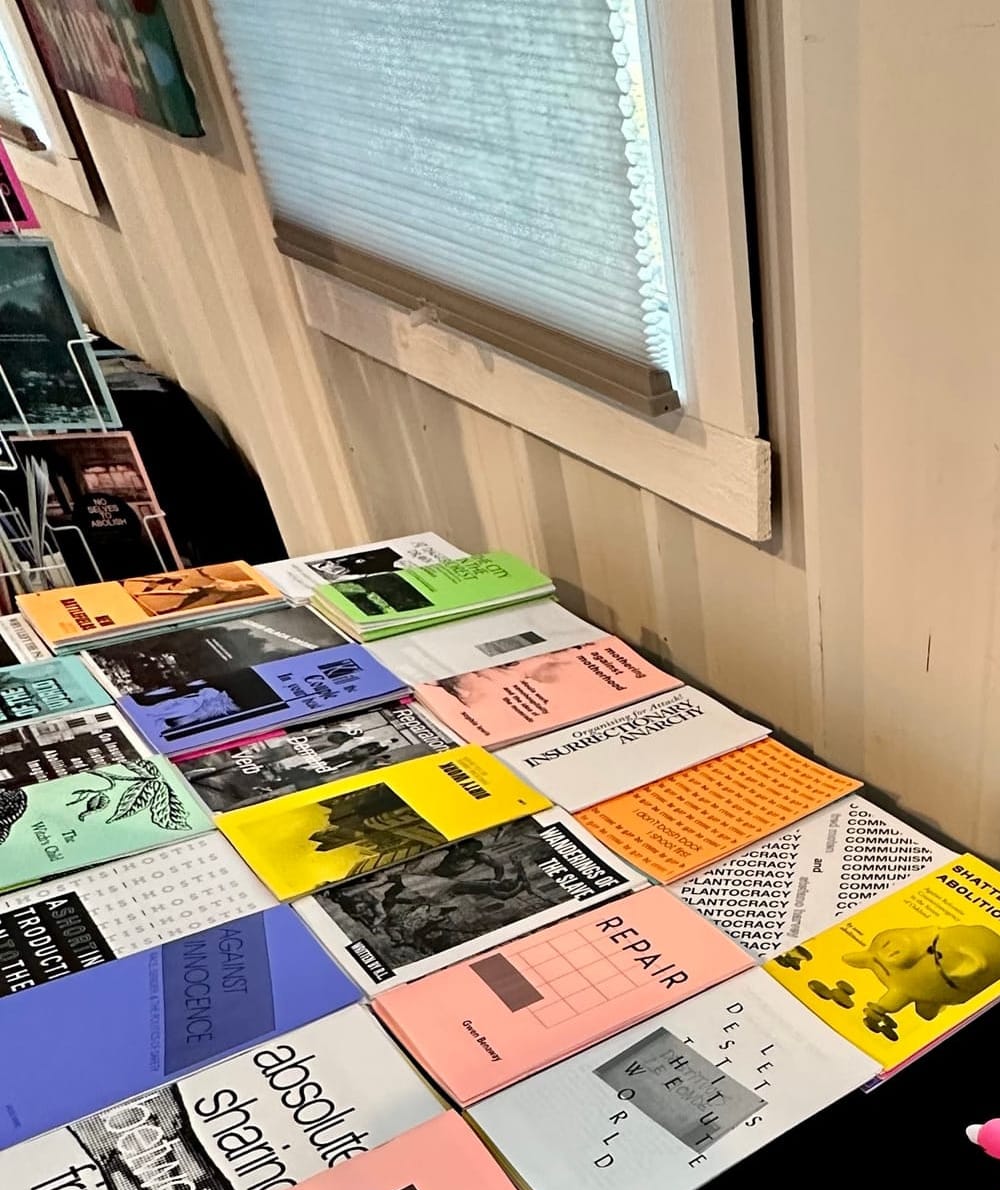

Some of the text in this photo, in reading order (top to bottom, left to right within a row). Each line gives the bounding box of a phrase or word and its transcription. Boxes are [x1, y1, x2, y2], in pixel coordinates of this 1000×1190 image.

[576, 655, 627, 691] motherhood
[591, 651, 624, 676] against
[604, 647, 647, 679] mothering
[524, 698, 693, 768] INSURRECTIONARY
[619, 705, 705, 745] ANARCHY
[534, 826, 610, 880] WANDERINGS
[592, 874, 620, 889] OF
[842, 854, 933, 863] COMMUNISM
[535, 857, 595, 900] THE SLAVE
[681, 887, 792, 898] PLANTOCRACY
[218, 928, 248, 995] AGAINST
[596, 915, 689, 990] REPAIR
[183, 941, 214, 1045] INNOCENCE
[462, 1019, 480, 1039] Gwen
[594, 1060, 646, 1169] WORLD
